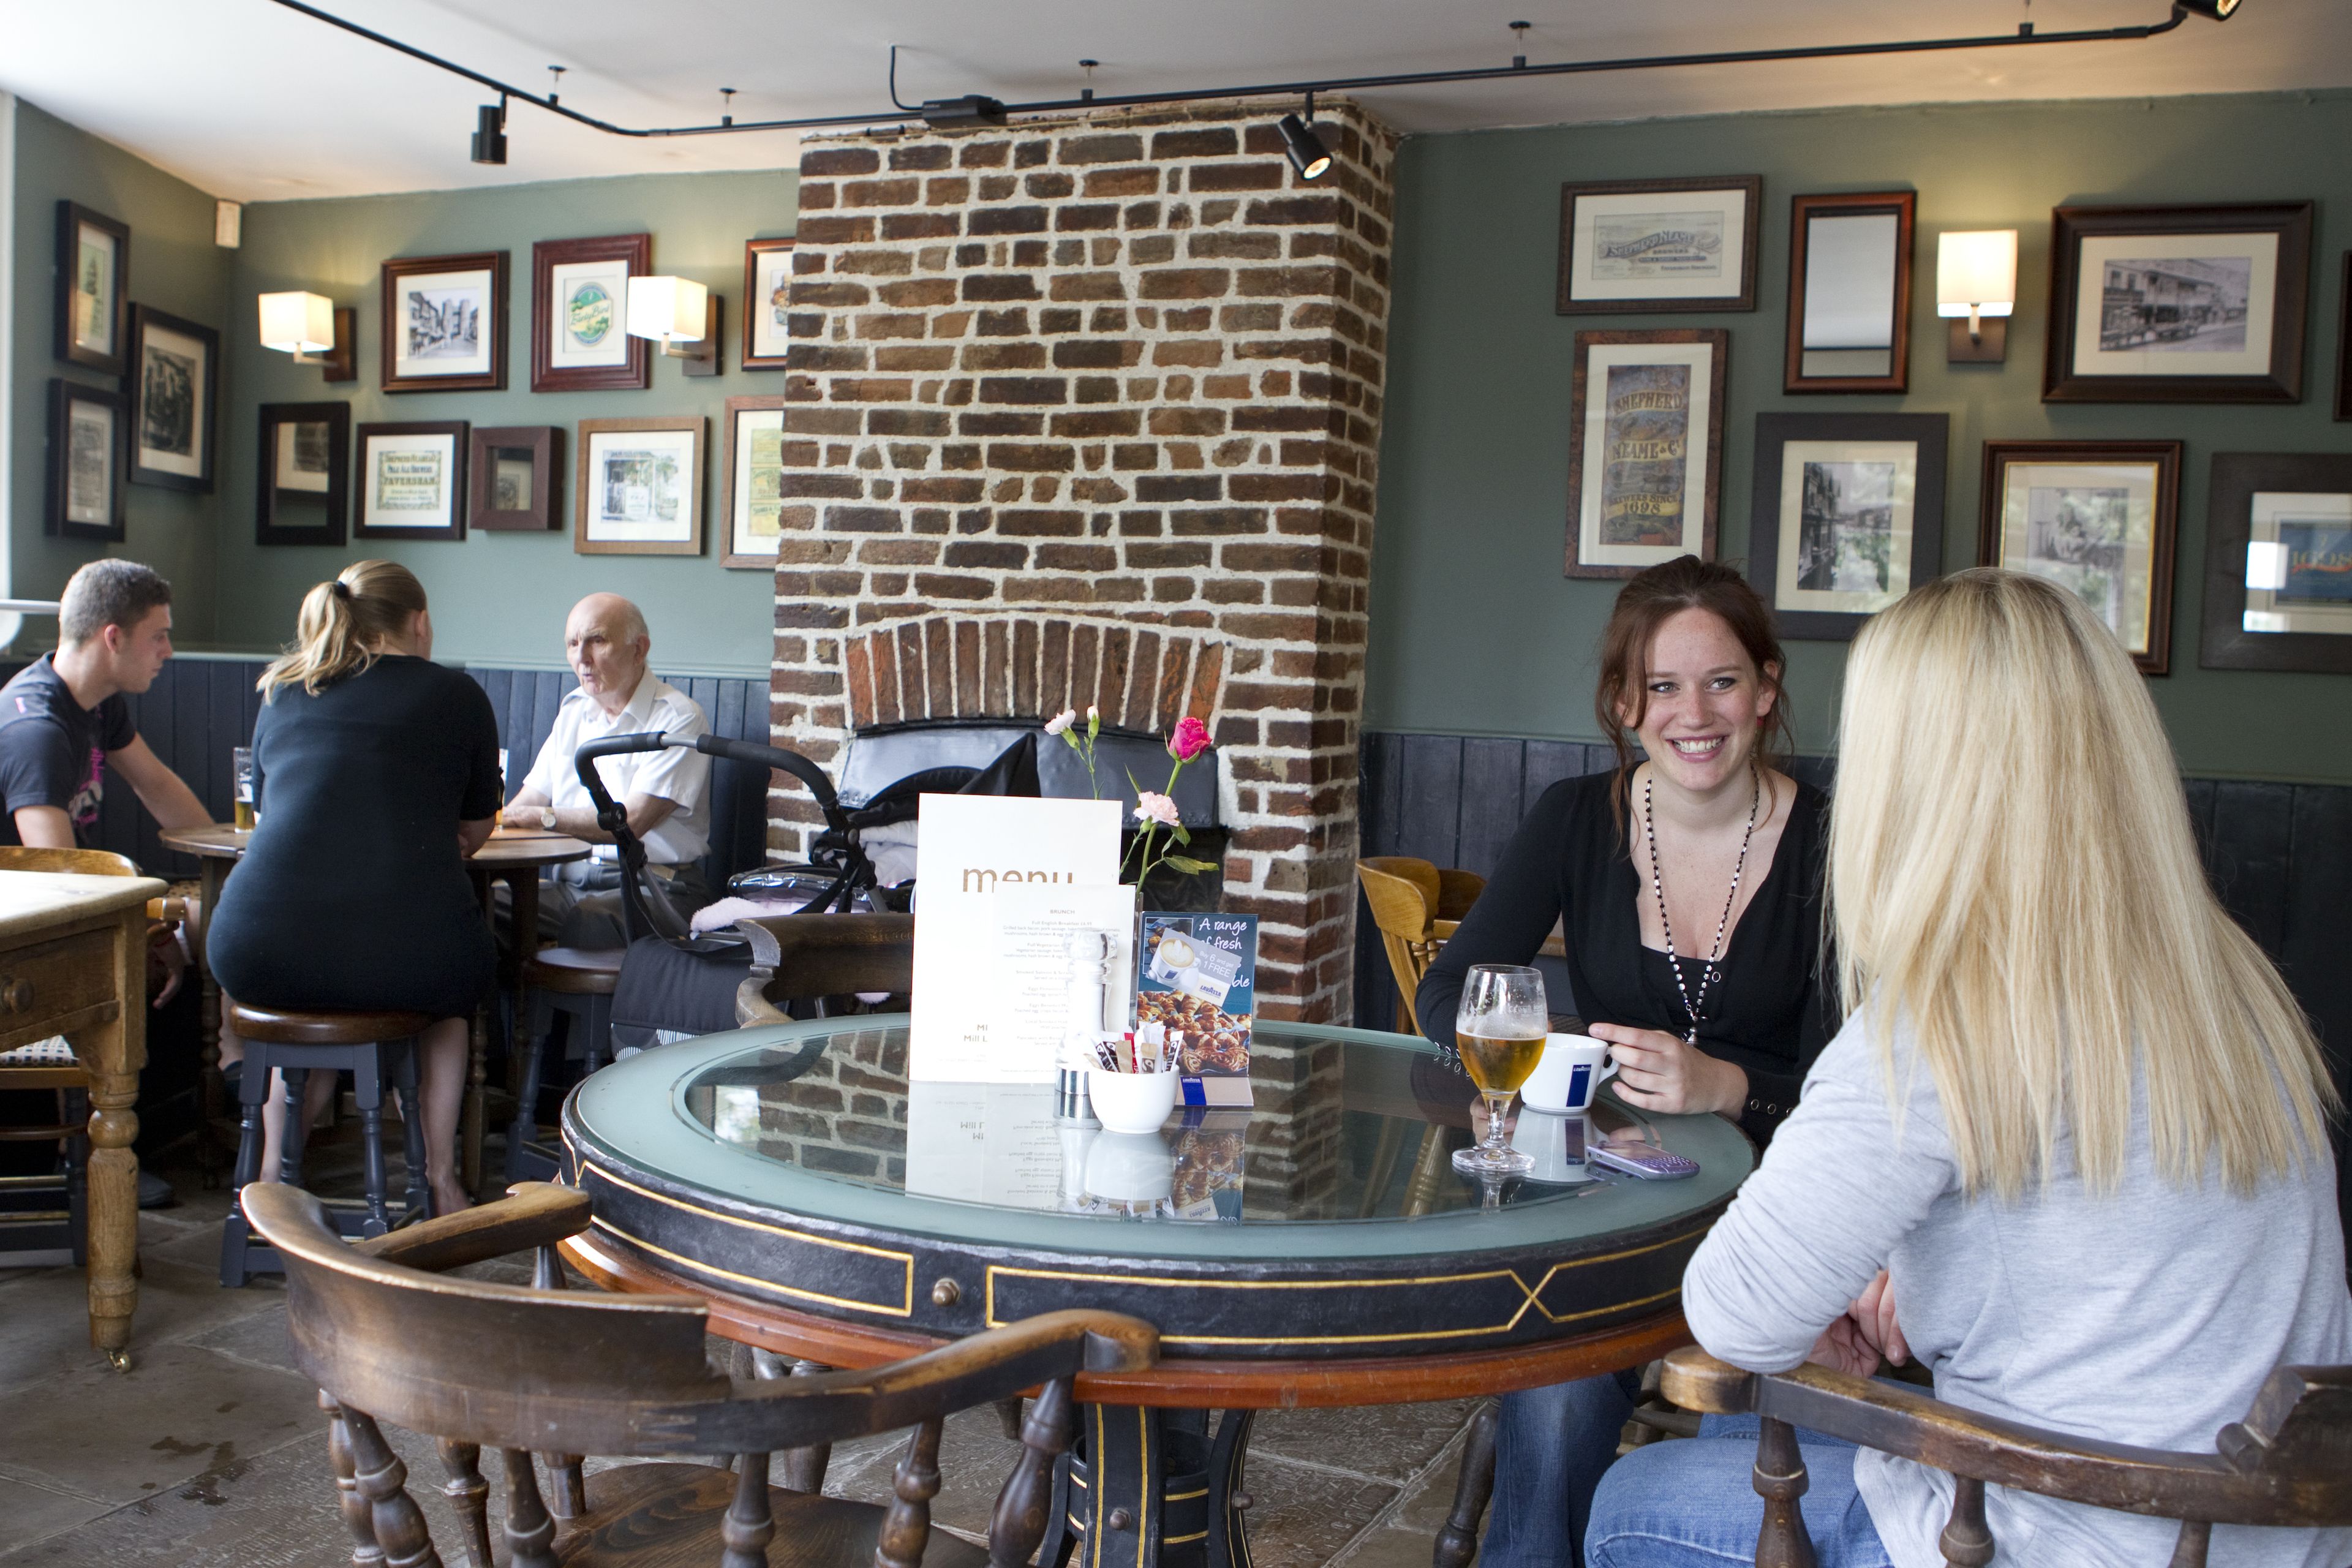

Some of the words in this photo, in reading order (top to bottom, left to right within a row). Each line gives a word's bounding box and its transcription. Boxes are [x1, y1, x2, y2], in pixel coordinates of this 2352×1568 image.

[1615, 392, 1682, 415] SHEPHERD
[1612, 442, 1658, 460] NEAME
[1623, 502, 1660, 515] 1698
[1199, 918, 1211, 931] A
[1214, 921, 1247, 936] range
[1214, 936, 1242, 950] fresh
[1199, 951, 1209, 959] Buy
[1210, 954, 1216, 962] 6
[1208, 963, 1232, 978] FREE
[1200, 985, 1221, 997] LAVAZZA
